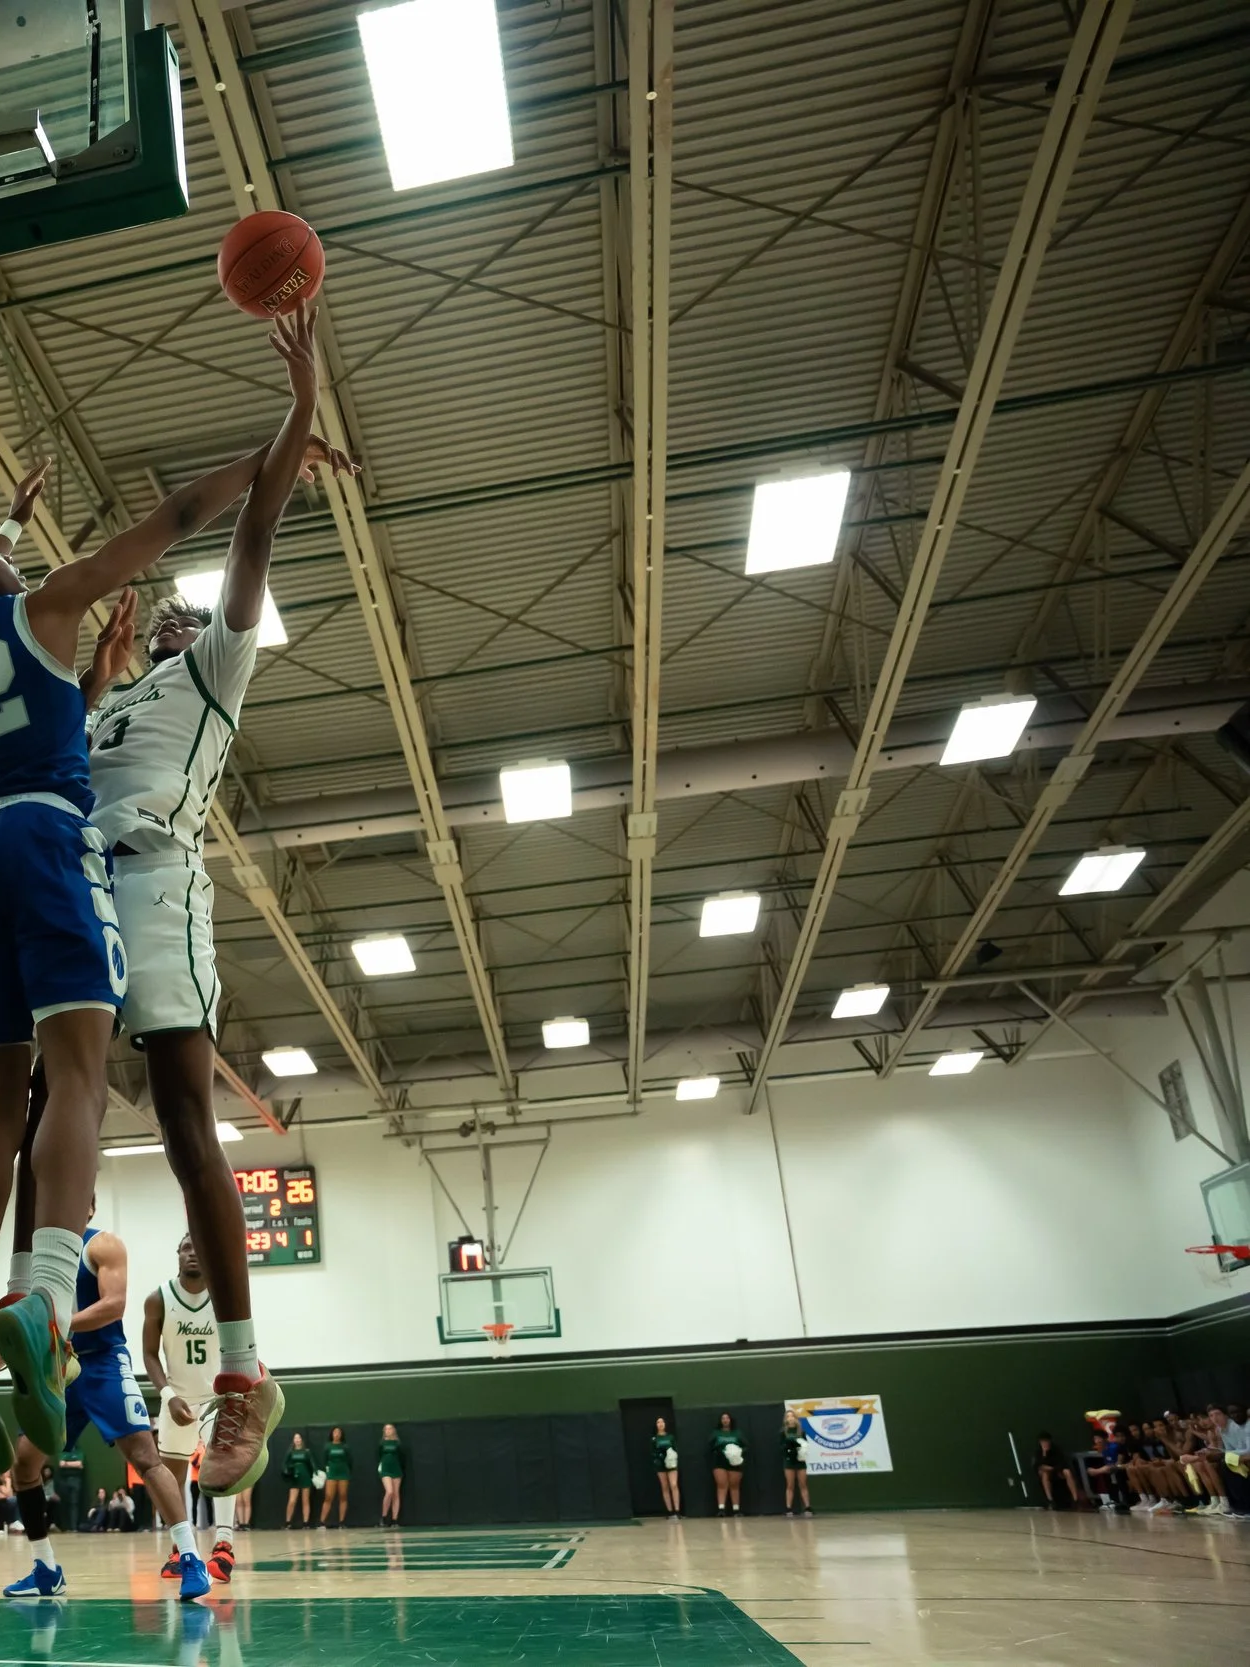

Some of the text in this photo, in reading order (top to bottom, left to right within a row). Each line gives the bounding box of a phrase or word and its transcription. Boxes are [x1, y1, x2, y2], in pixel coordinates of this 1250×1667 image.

[258, 268, 312, 314] NAIA
[287, 1180, 314, 1204] 26
[270, 1198, 281, 1216] 2
[275, 1232, 288, 1247] 4
[305, 1230, 312, 1246] 1
[176, 1321, 215, 1336] Woods
[186, 1340, 206, 1364] 15
[809, 1457, 858, 1472] TANDEM
